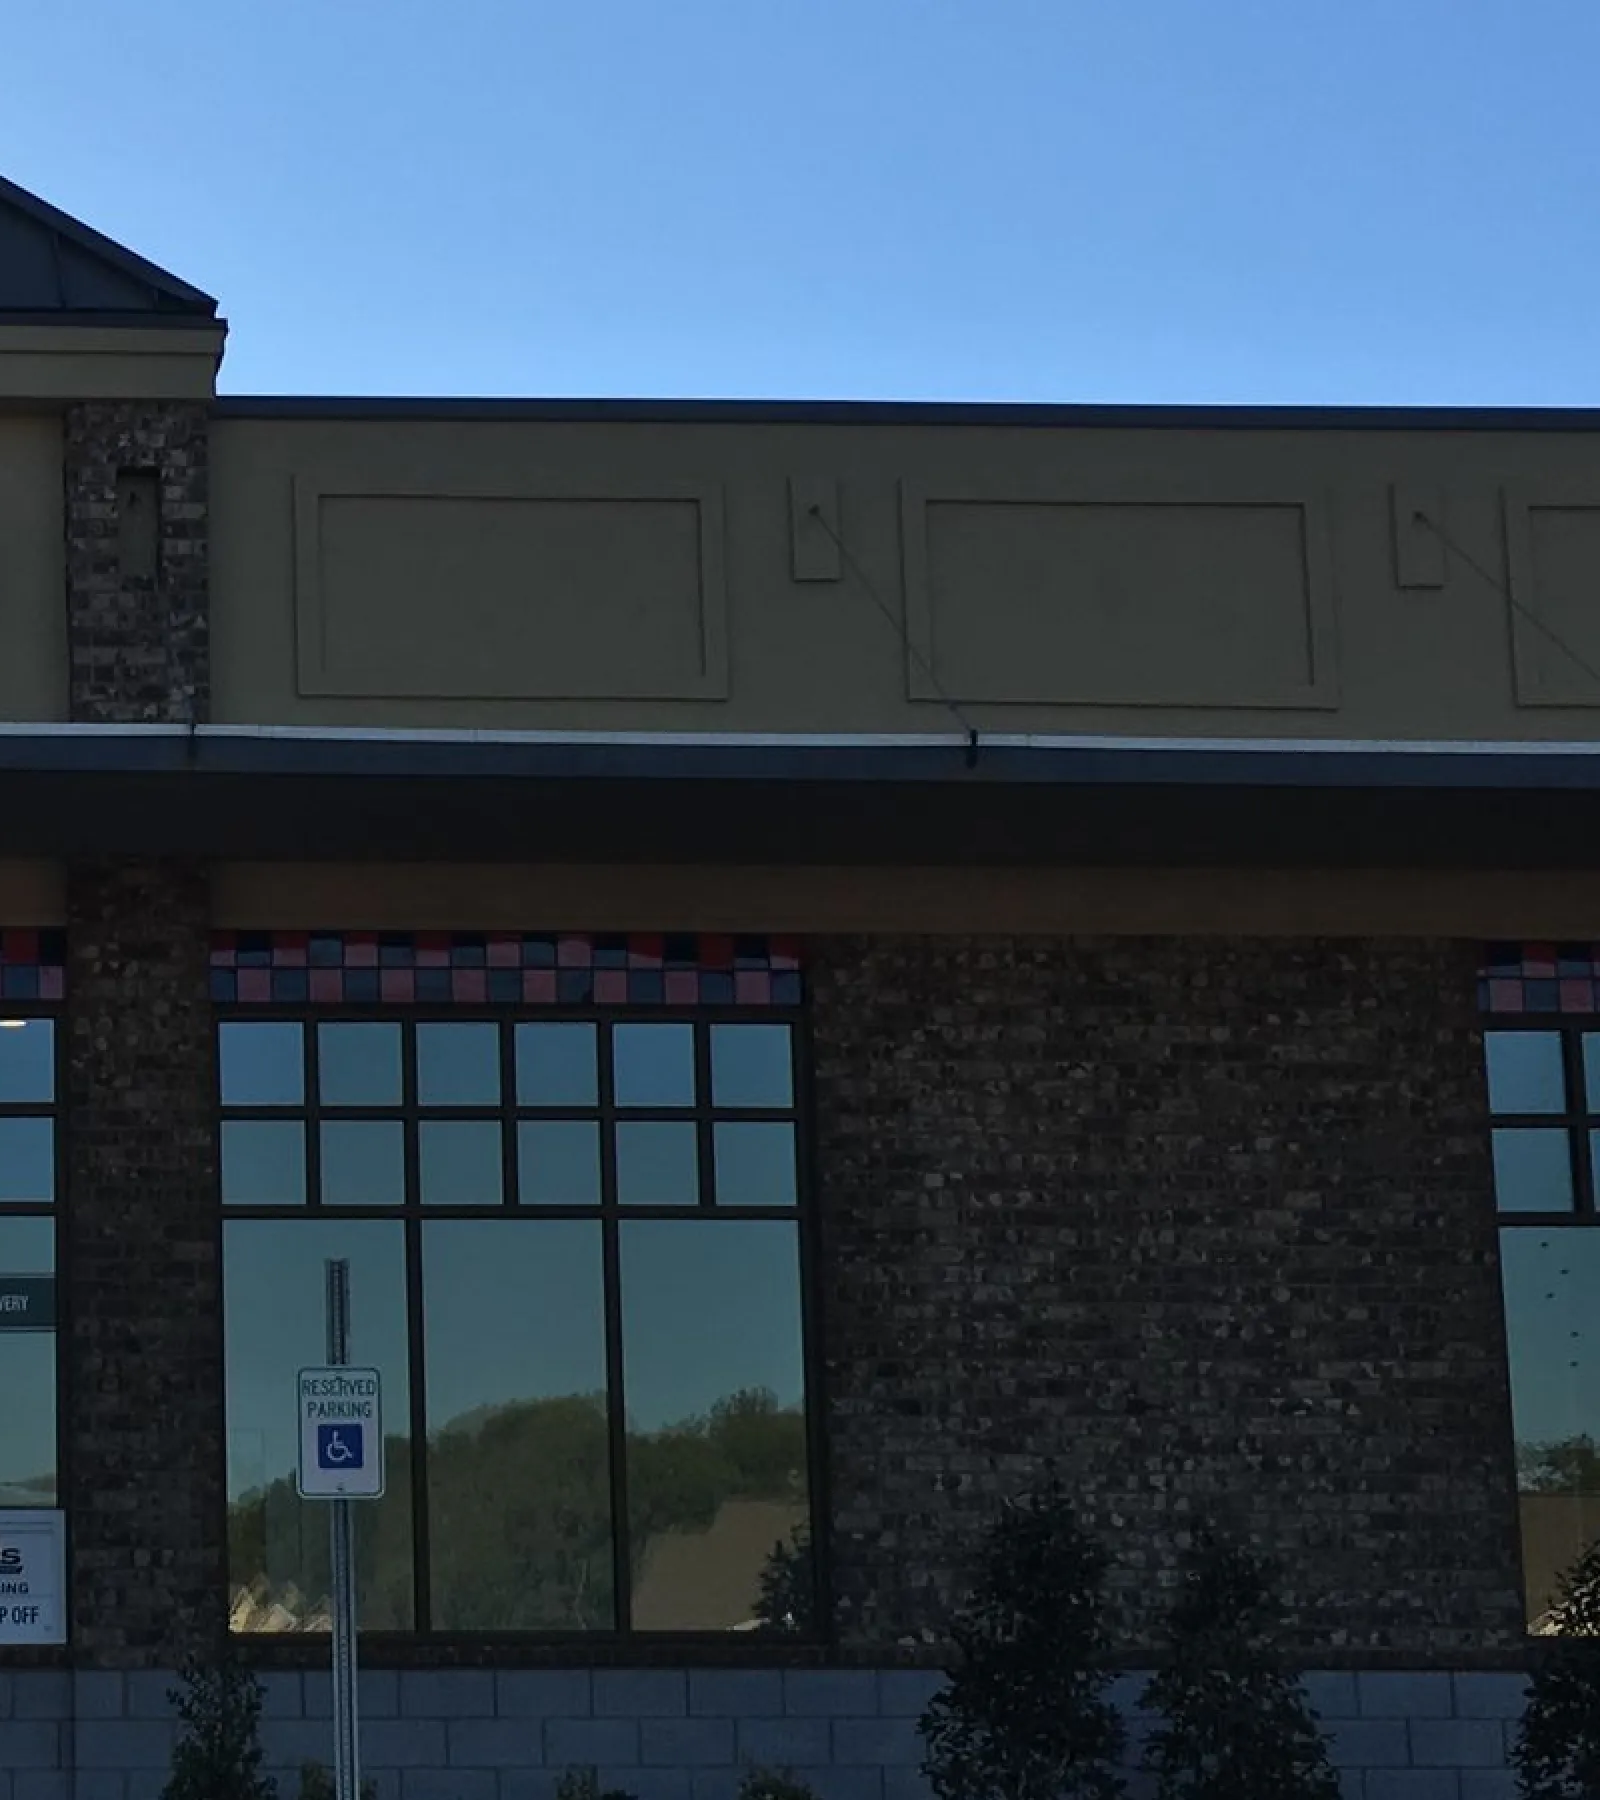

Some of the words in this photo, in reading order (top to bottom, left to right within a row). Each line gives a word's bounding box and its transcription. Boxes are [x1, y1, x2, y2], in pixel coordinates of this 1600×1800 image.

[303, 1379, 376, 1397] RESERVED
[307, 1401, 373, 1418] PARKING
[11, 1605, 40, 1625] OFF
